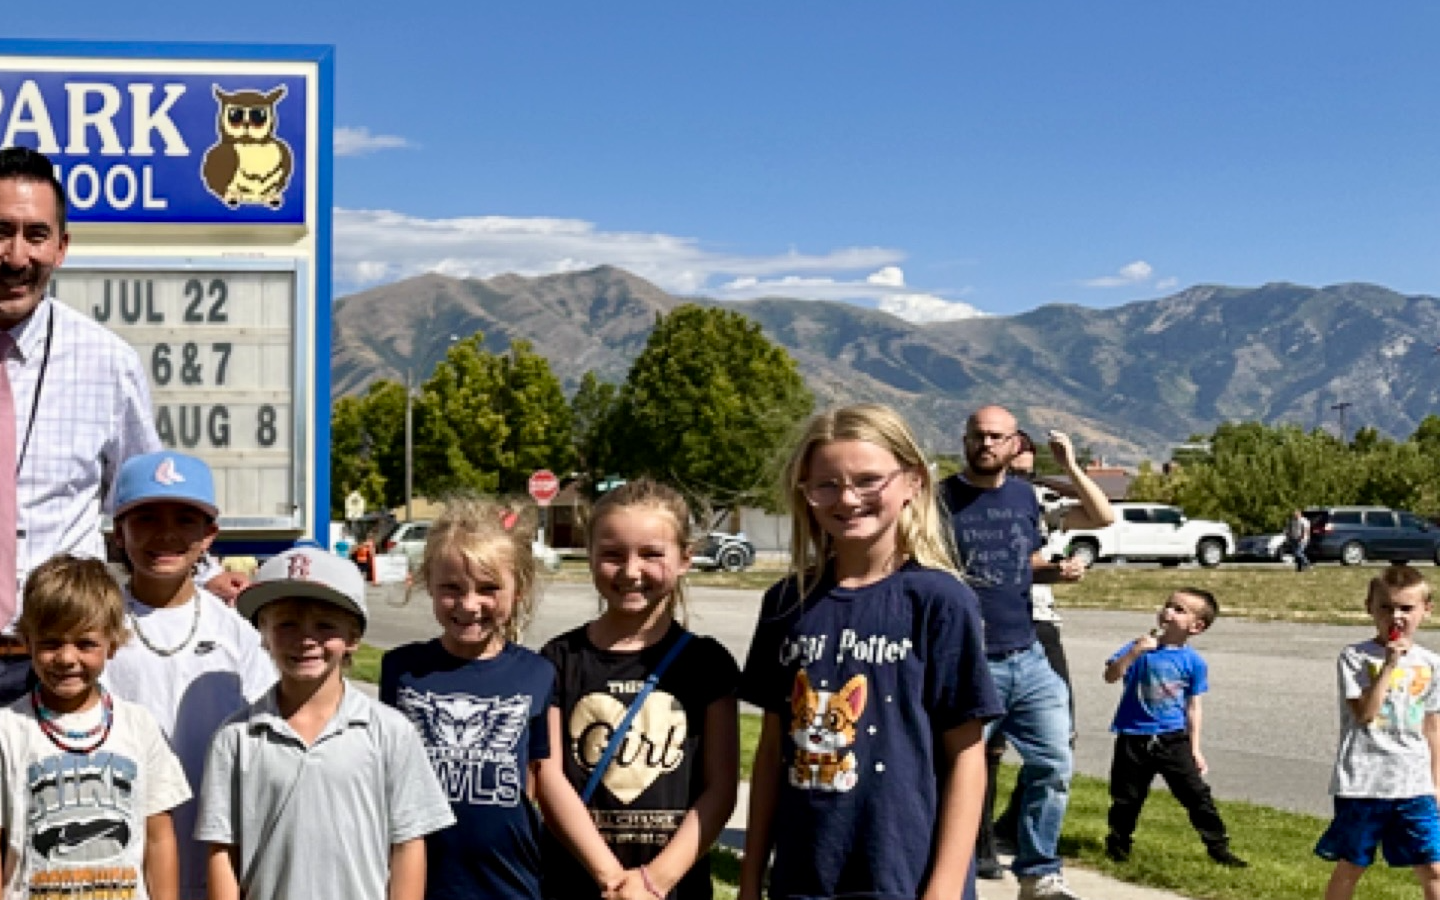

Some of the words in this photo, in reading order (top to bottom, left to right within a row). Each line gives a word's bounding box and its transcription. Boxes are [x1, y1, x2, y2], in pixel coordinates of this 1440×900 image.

[94, 279, 164, 323] JUL
[184, 279, 229, 323] 22
[151, 343, 233, 385] 6&7
[156, 404, 231, 447] AUG
[258, 404, 278, 447] 8
[836, 628, 913, 665] Potter
[432, 758, 521, 808] WLS
